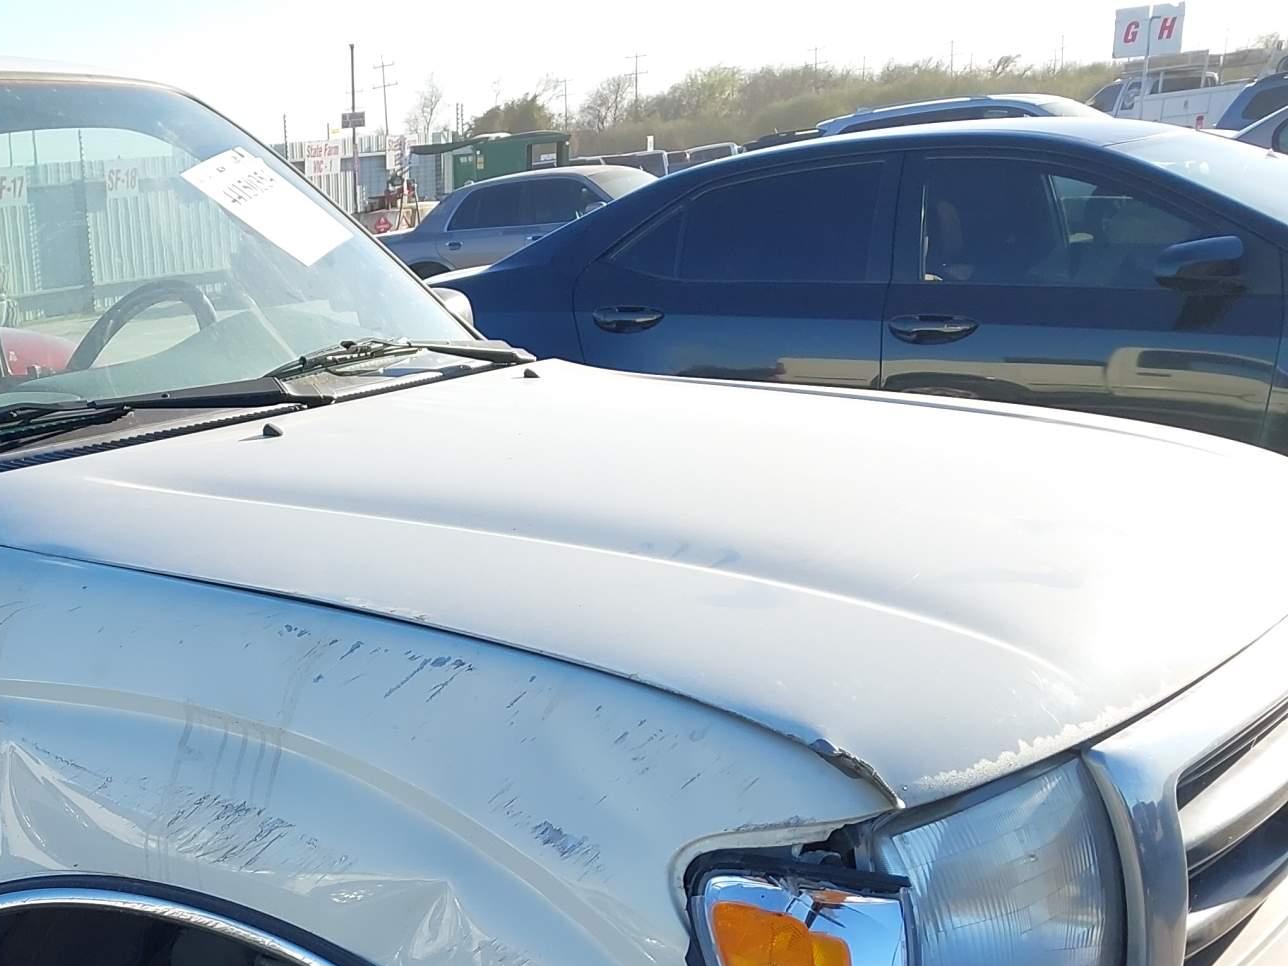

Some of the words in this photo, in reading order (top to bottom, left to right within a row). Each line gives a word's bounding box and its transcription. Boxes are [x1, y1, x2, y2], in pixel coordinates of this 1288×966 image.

[1123, 20, 1140, 43] G
[1158, 16, 1177, 40] H
[107, 167, 137, 191] SF-18
